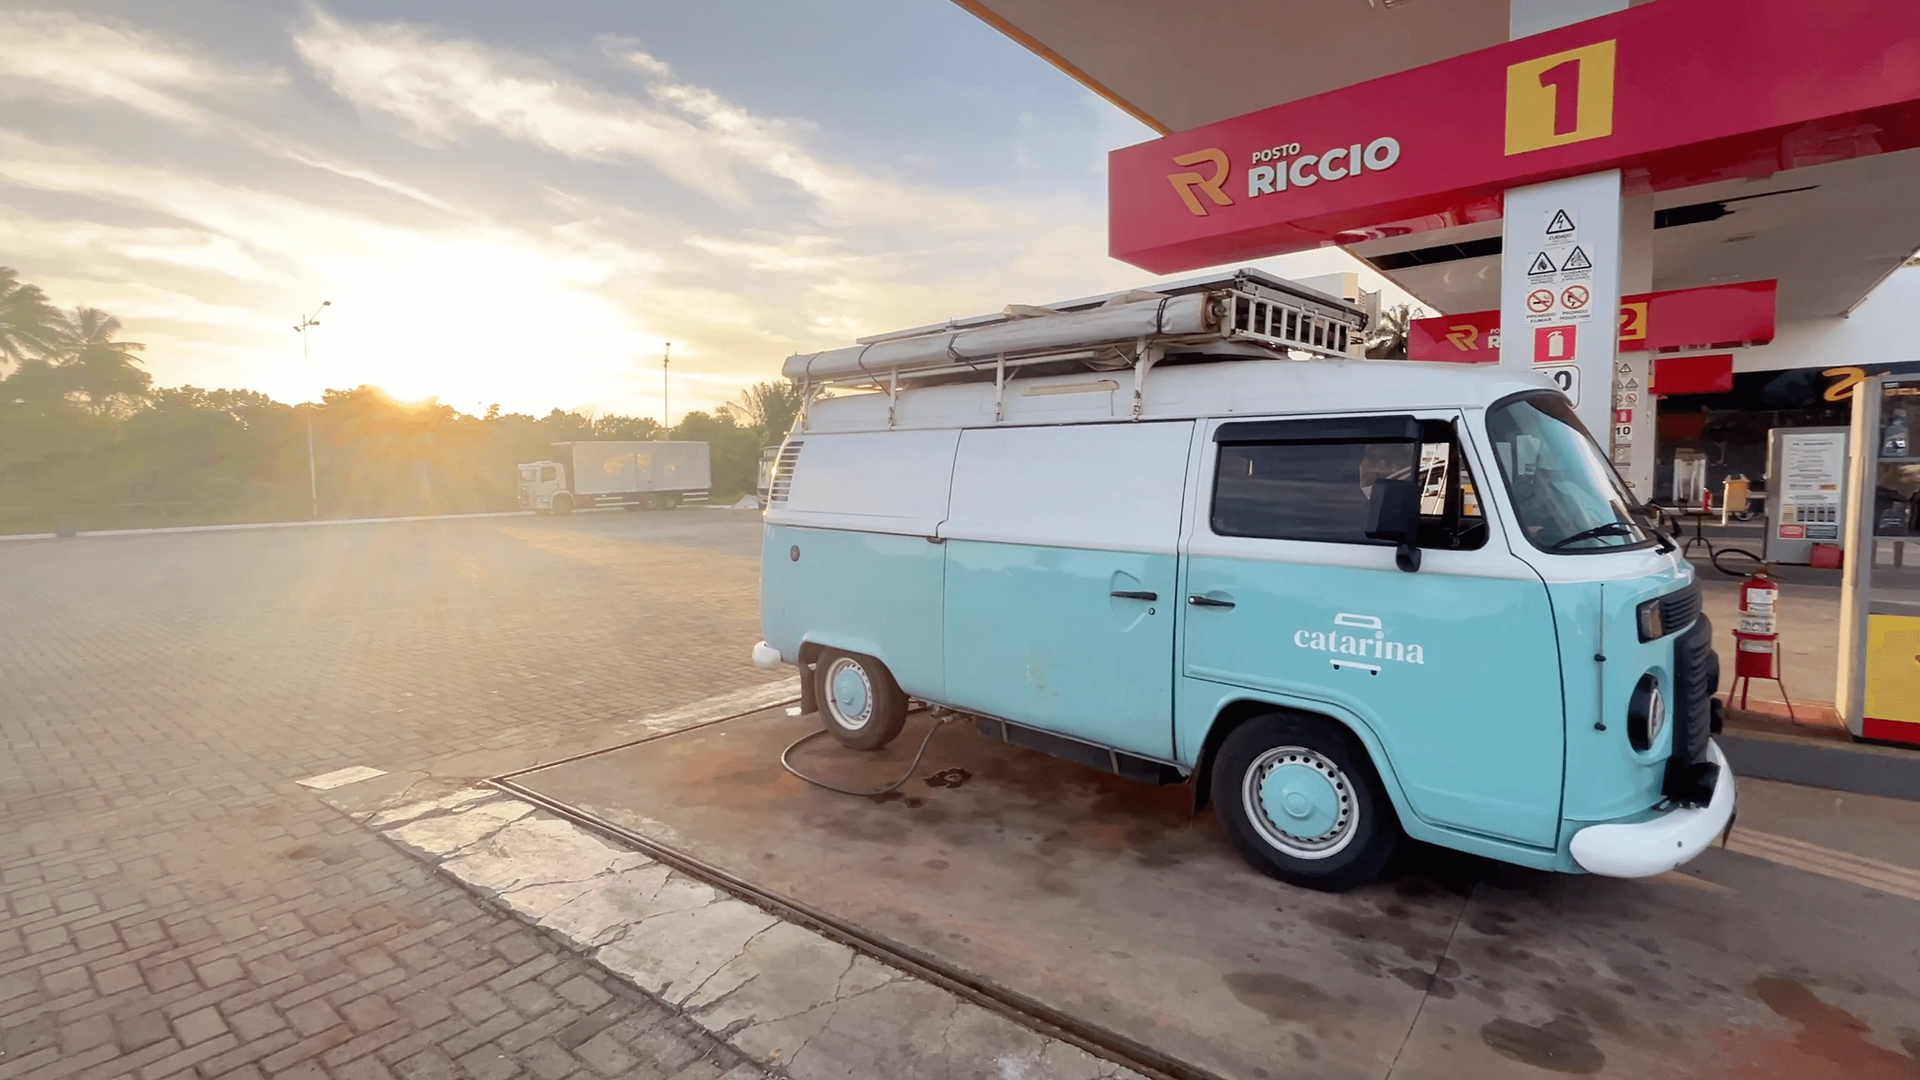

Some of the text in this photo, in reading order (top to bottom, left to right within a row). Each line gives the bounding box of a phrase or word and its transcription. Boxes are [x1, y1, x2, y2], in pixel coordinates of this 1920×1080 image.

[1538, 58, 1581, 137] 1
[1248, 136, 1401, 198] RICCIO
[1252, 142, 1301, 164] POSTO
[1619, 307, 1638, 336] 2
[1615, 426, 1631, 435] 10
[1294, 630, 1425, 665] catarina
